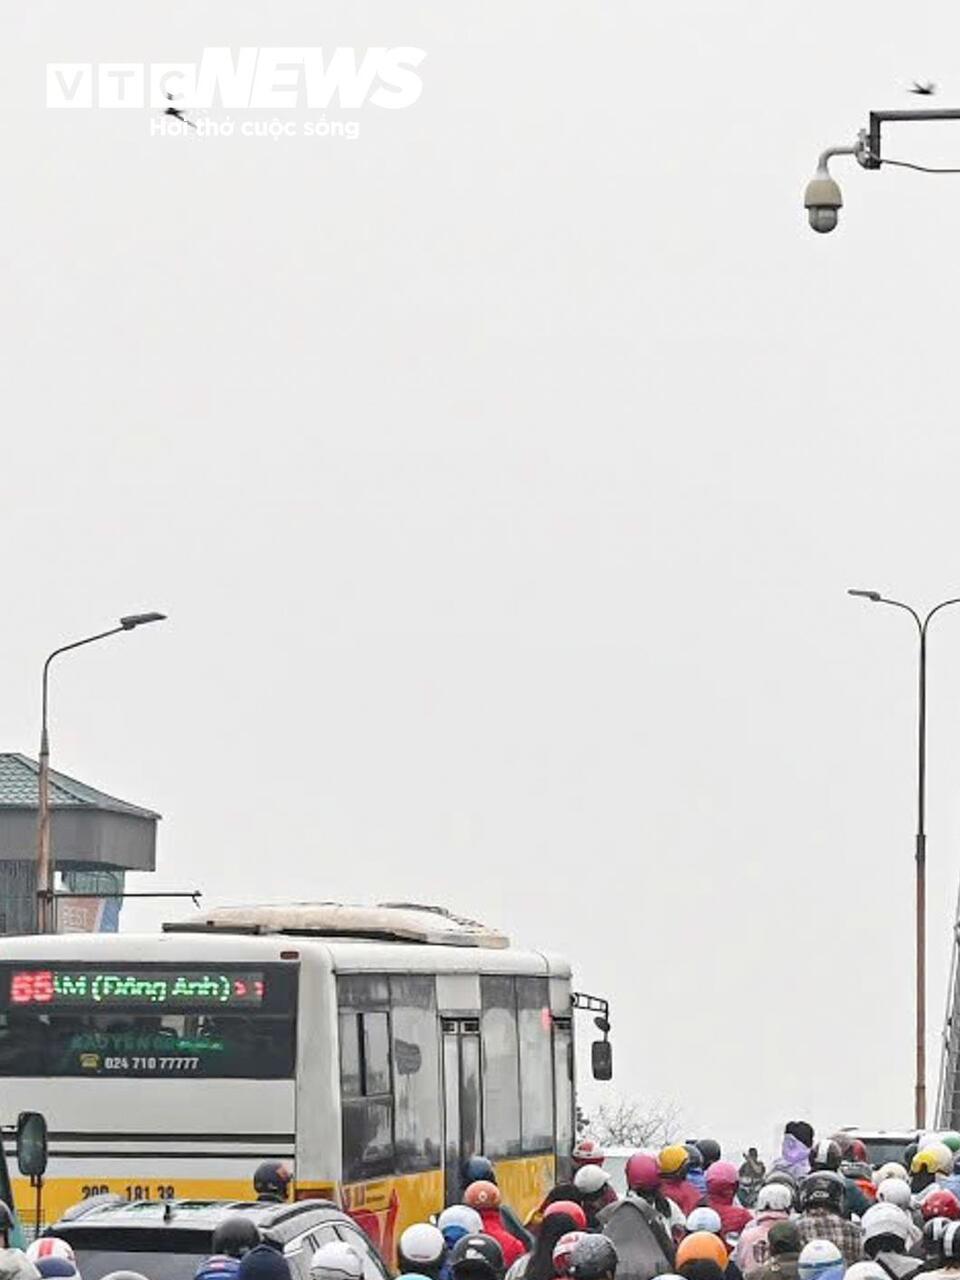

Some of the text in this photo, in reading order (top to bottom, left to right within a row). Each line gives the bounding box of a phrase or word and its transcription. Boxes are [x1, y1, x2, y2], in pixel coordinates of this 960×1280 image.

[103, 1056, 201, 1070] 024 710 77777
